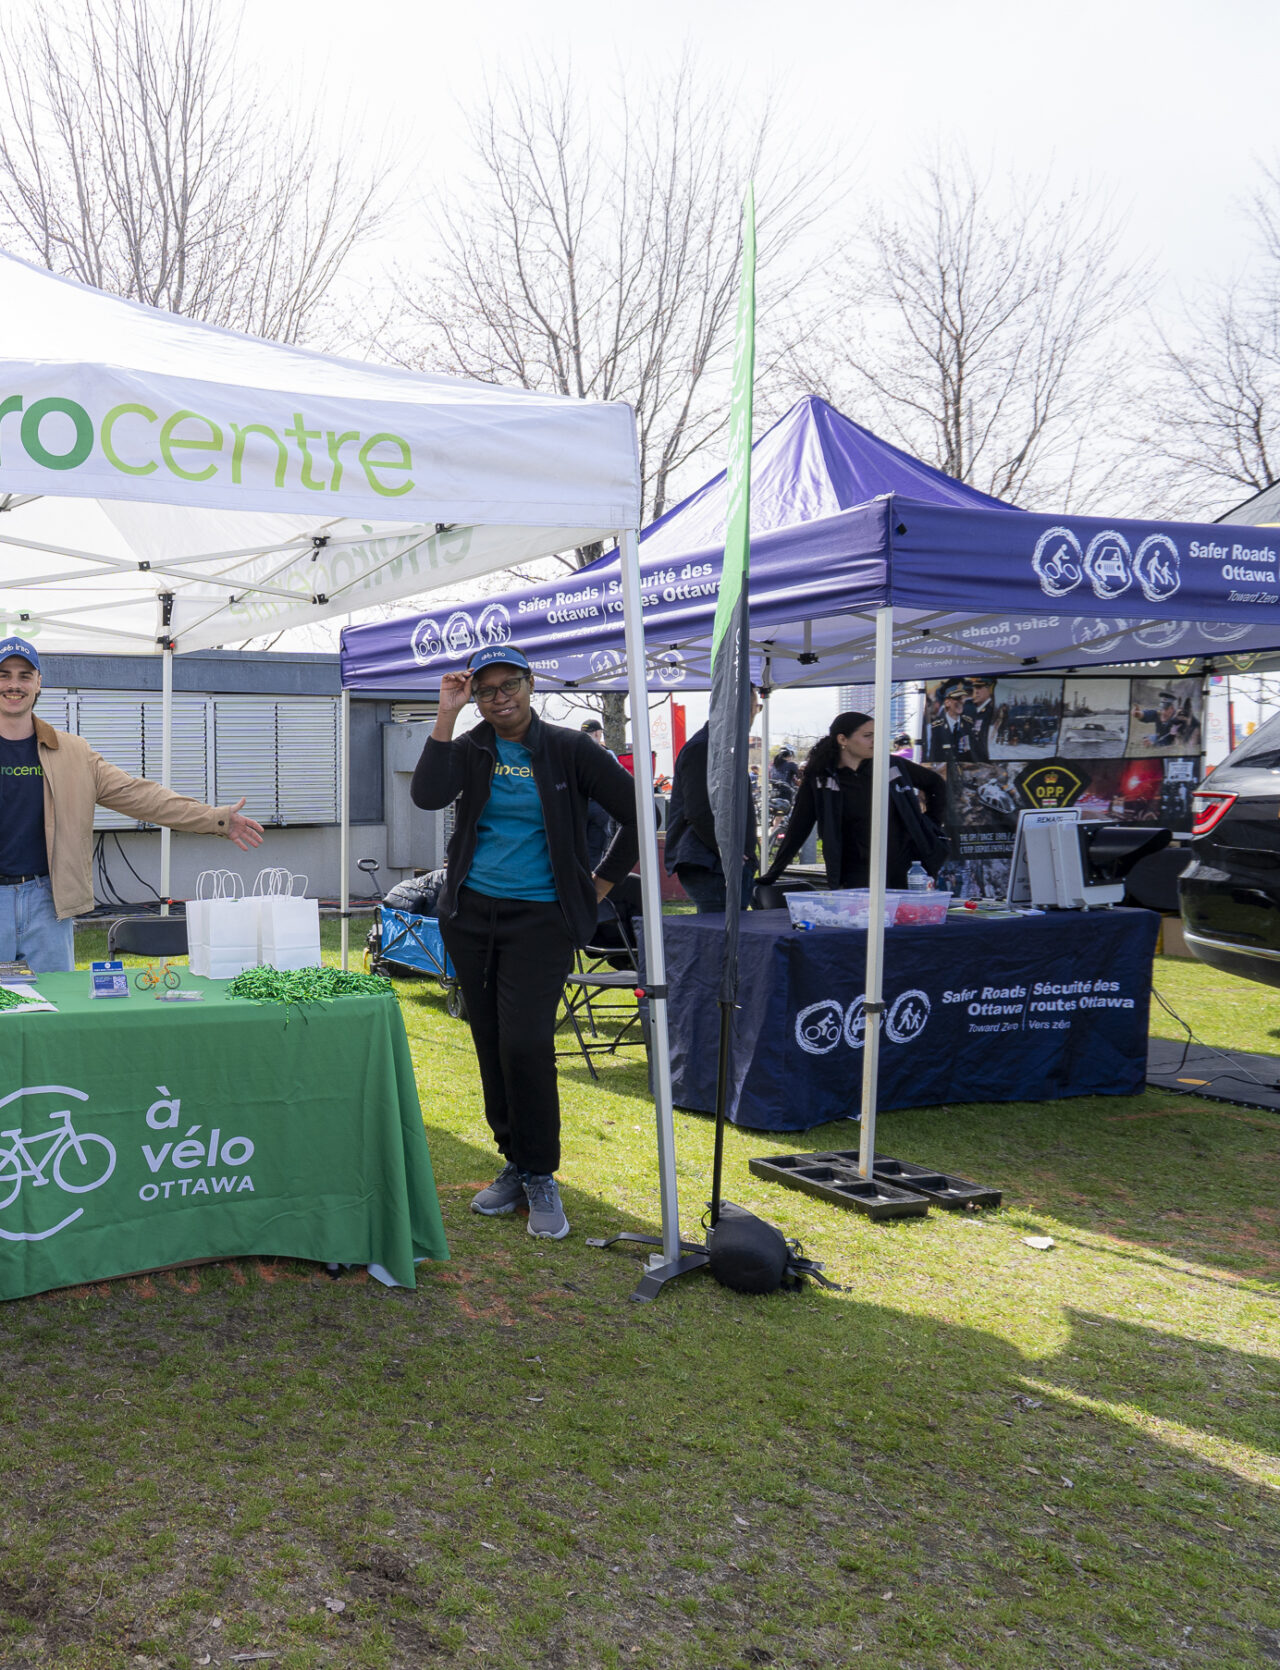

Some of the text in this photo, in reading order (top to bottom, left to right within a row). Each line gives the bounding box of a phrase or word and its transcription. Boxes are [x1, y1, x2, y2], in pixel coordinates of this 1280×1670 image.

[1189, 541, 1276, 562] Safer Roads
[681, 562, 713, 581] des
[1222, 564, 1276, 583] Ottawa
[518, 586, 599, 614] Safer Roads
[608, 594, 659, 614] roes
[1227, 590, 1257, 602] Toward
[547, 605, 599, 624] Ottawa
[1, 765, 44, 776] rocent
[942, 985, 1026, 1004] Safer Roads
[1033, 979, 1120, 996] Sécurité des
[967, 1002, 1024, 1016] Ottawa
[1029, 996, 1135, 1012] routes Ottawa
[968, 1022, 999, 1033] Toward
[1028, 1019, 1050, 1030] Vers
[145, 1086, 180, 1130] à
[141, 1125, 256, 1173] vélo
[138, 1176, 256, 1202] OTTAWA
